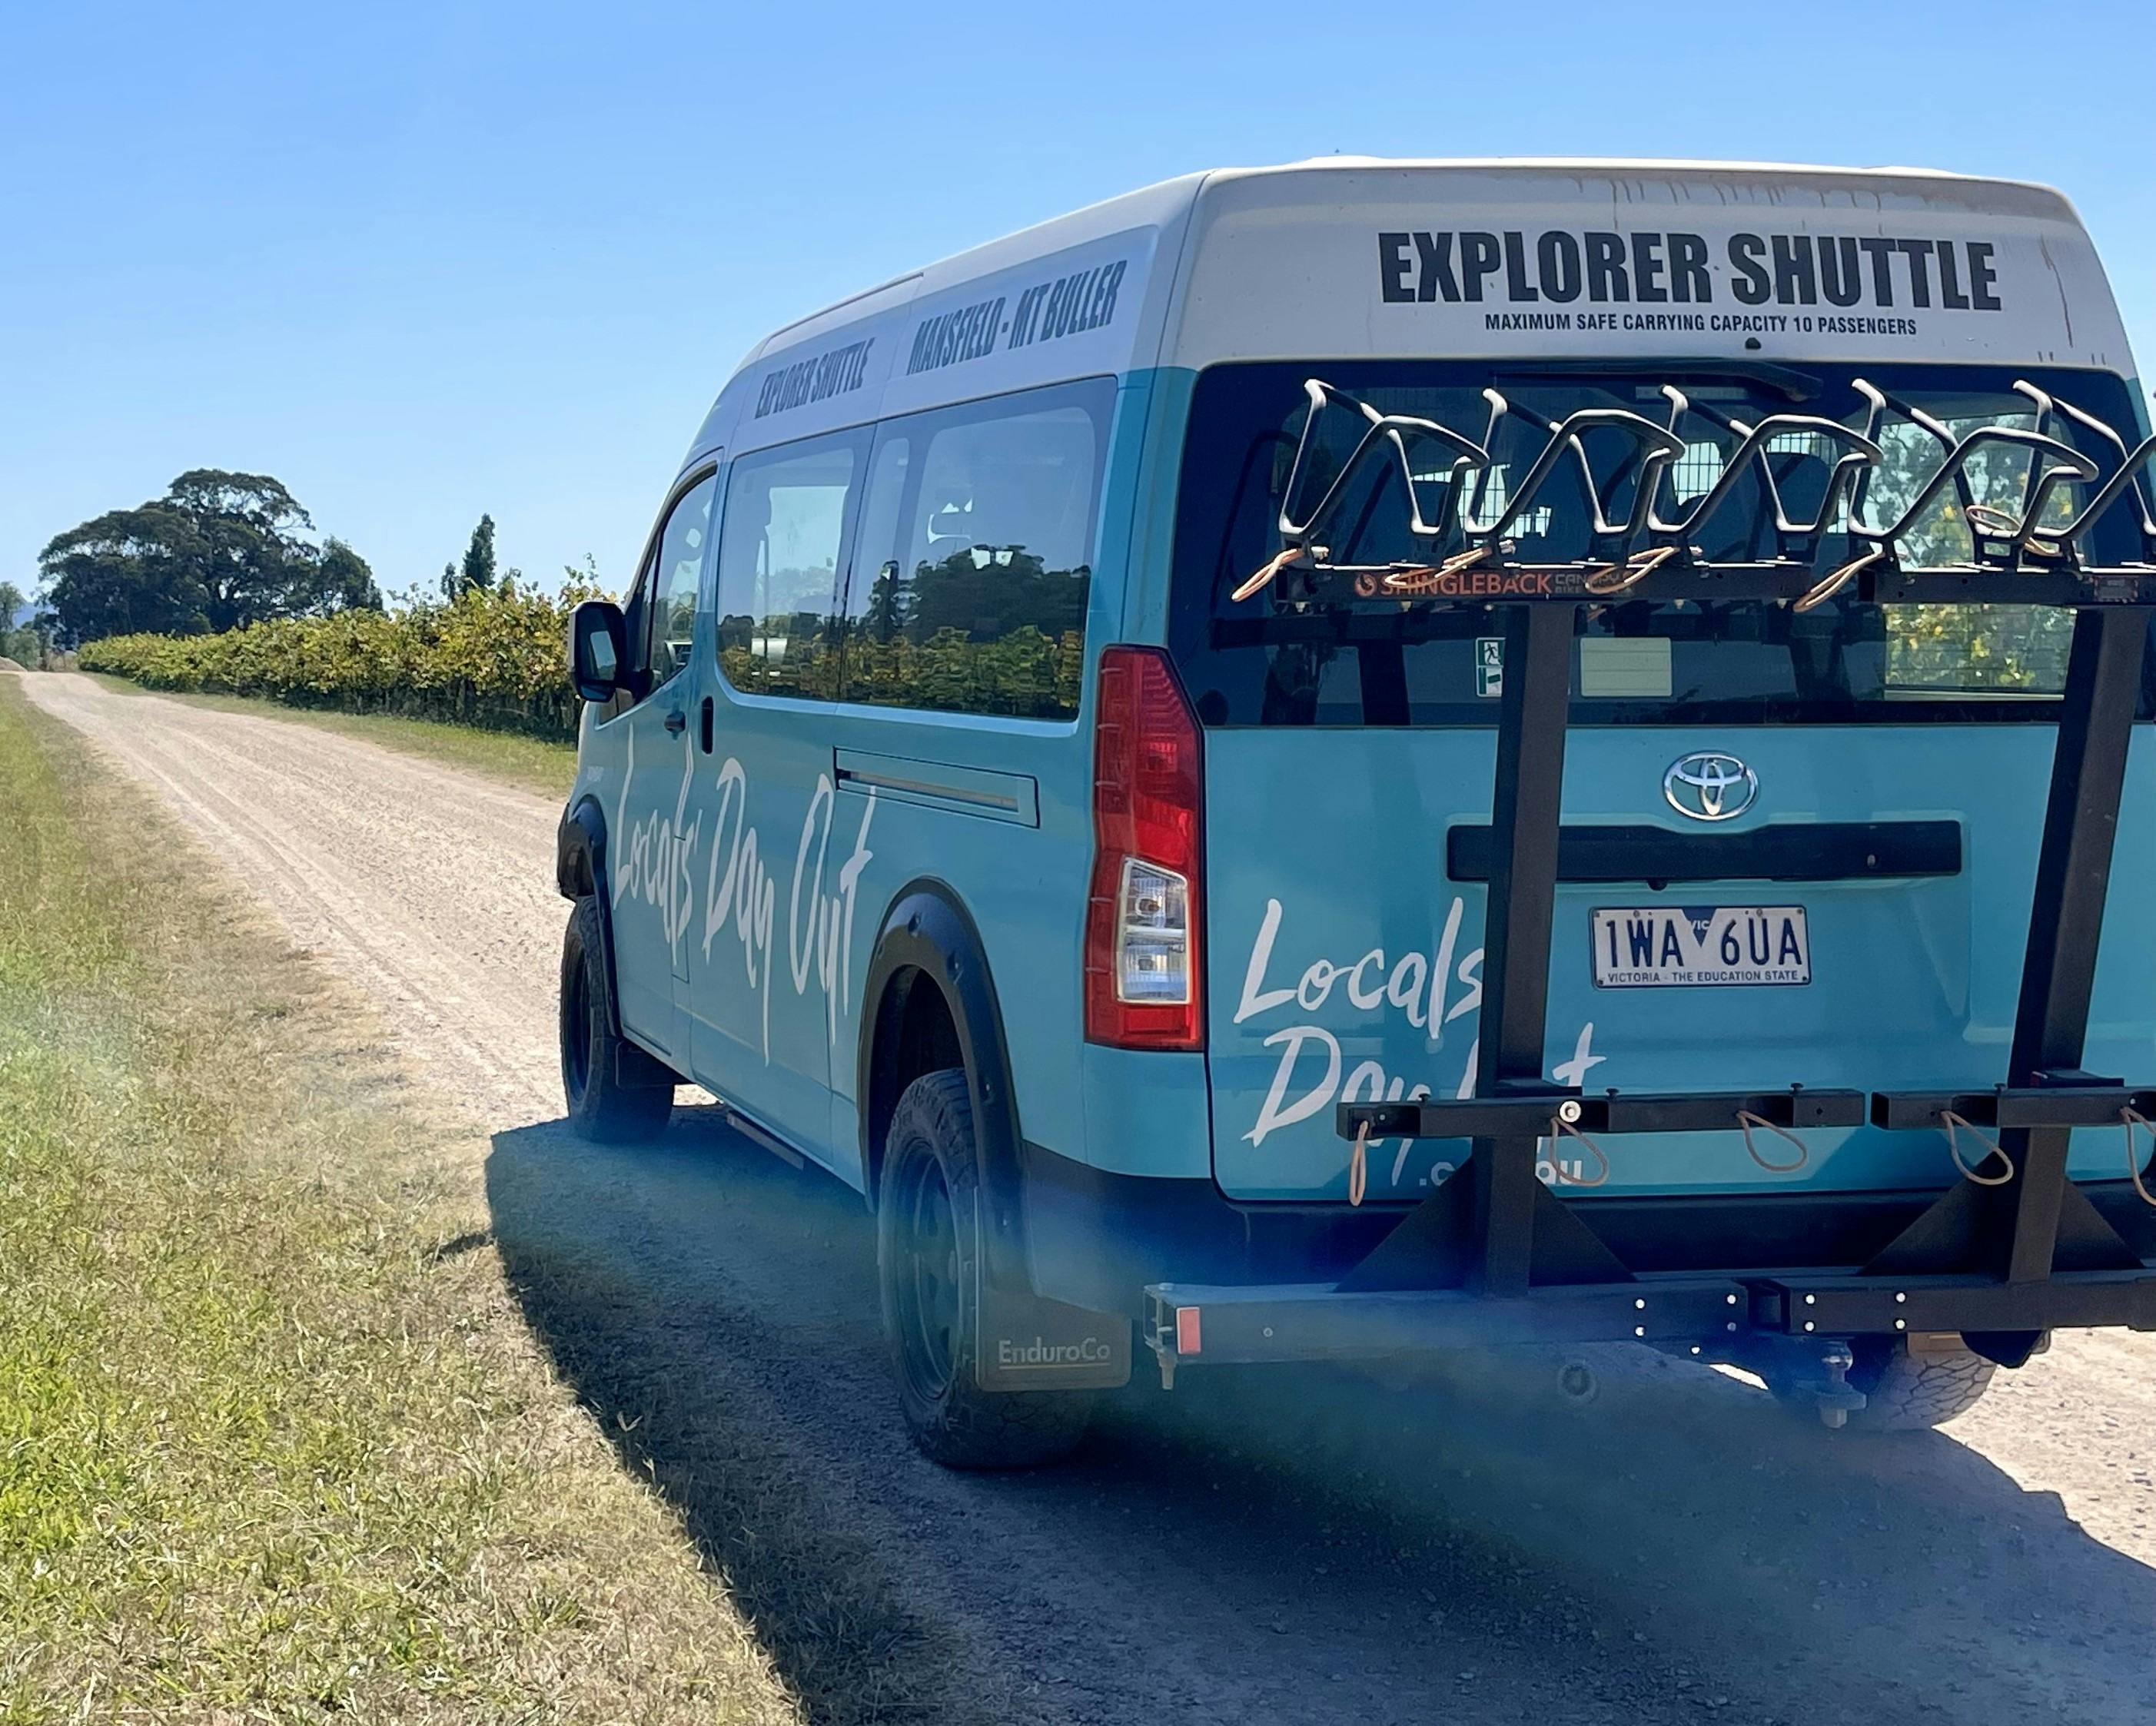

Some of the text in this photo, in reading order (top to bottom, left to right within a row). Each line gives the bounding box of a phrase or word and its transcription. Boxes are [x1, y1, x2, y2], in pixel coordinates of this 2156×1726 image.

[1377, 231, 2002, 311] EXPLORER SHUTTLE
[906, 297, 1006, 376] MANSFIELD
[1008, 282, 1051, 350] MT
[1039, 260, 1128, 343] BULLER
[1485, 314, 1917, 335] MAXIMUM SAFE CARRYING CAPACITY 10 PASSENGERS
[755, 337, 876, 419] EXPLORER SHUTTLE
[1555, 573, 1620, 585] CANPY
[702, 758, 774, 1067] Day
[789, 773, 876, 1045] Out
[1606, 918, 1802, 968] 1WA 6UA
[1233, 896, 1484, 1040] Locals
[1608, 971, 1660, 983] VICTORIA
[1672, 971, 1693, 982] THE
[1697, 971, 1762, 982] EDUCATION
[1764, 970, 1798, 981] STATE
[999, 1336, 1111, 1363] EnduroCo
